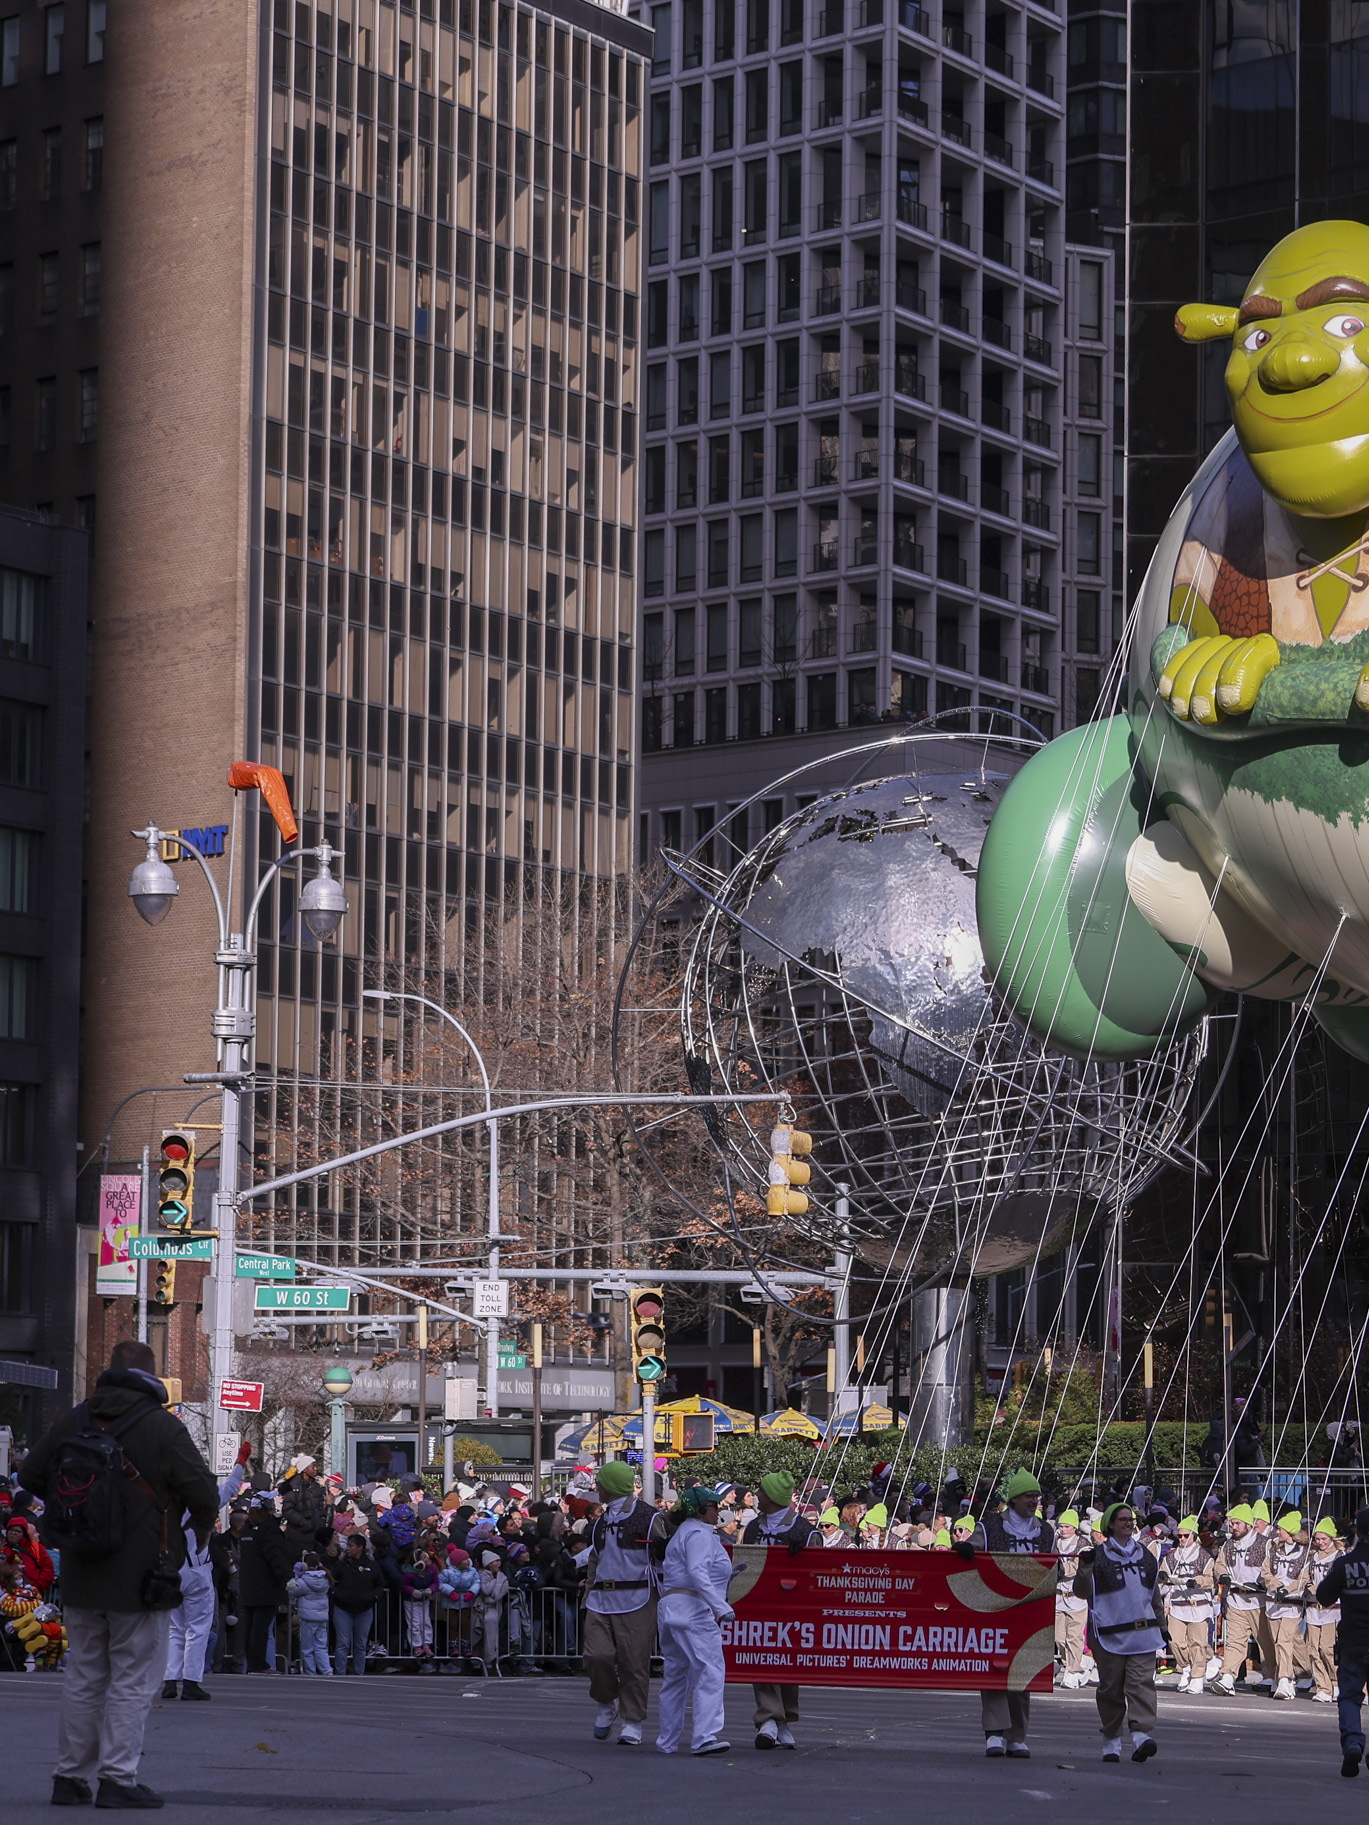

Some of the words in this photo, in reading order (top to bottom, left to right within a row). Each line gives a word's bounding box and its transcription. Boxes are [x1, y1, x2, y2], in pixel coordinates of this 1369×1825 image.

[183, 825, 227, 858] NYIT
[122, 1183, 128, 1192] A
[106, 1191, 137, 1200] GREAT
[106, 1200, 136, 1209] PLACE
[114, 1209, 127, 1218] TO
[133, 1241, 193, 1256] Columbus
[198, 1240, 209, 1249] Cir
[238, 1258, 268, 1270] Central
[272, 1259, 290, 1270] Park
[276, 1291, 288, 1304] W
[294, 1291, 310, 1304] 60
[316, 1292, 329, 1305] St
[500, 1357, 506, 1367] W
[508, 1357, 516, 1367] 60
[231, 1383, 256, 1391] STOPPING
[498, 1381, 512, 1394] ORK
[515, 1379, 552, 1395] INSTITE
[553, 1382, 563, 1396] OF
[563, 1381, 611, 1398] TECHNOLOGY
[775, 1428, 816, 1436] SABRETT
[853, 1564, 890, 1576] macy's
[816, 1576, 892, 1589] THANKSGIVING
[895, 1578, 915, 1590] DAY
[845, 1591, 885, 1603] PARADE
[822, 1609, 907, 1618] PRESENTS
[720, 1620, 815, 1648] SHREK'S
[822, 1623, 891, 1650] ONION
[899, 1626, 1009, 1654] CARRIAGE
[735, 1652, 793, 1666] UNIVERSAL
[797, 1654, 850, 1667] PICTURES'
[853, 1656, 928, 1670] DREAMWORKS
[931, 1658, 990, 1672] ANIMATION
